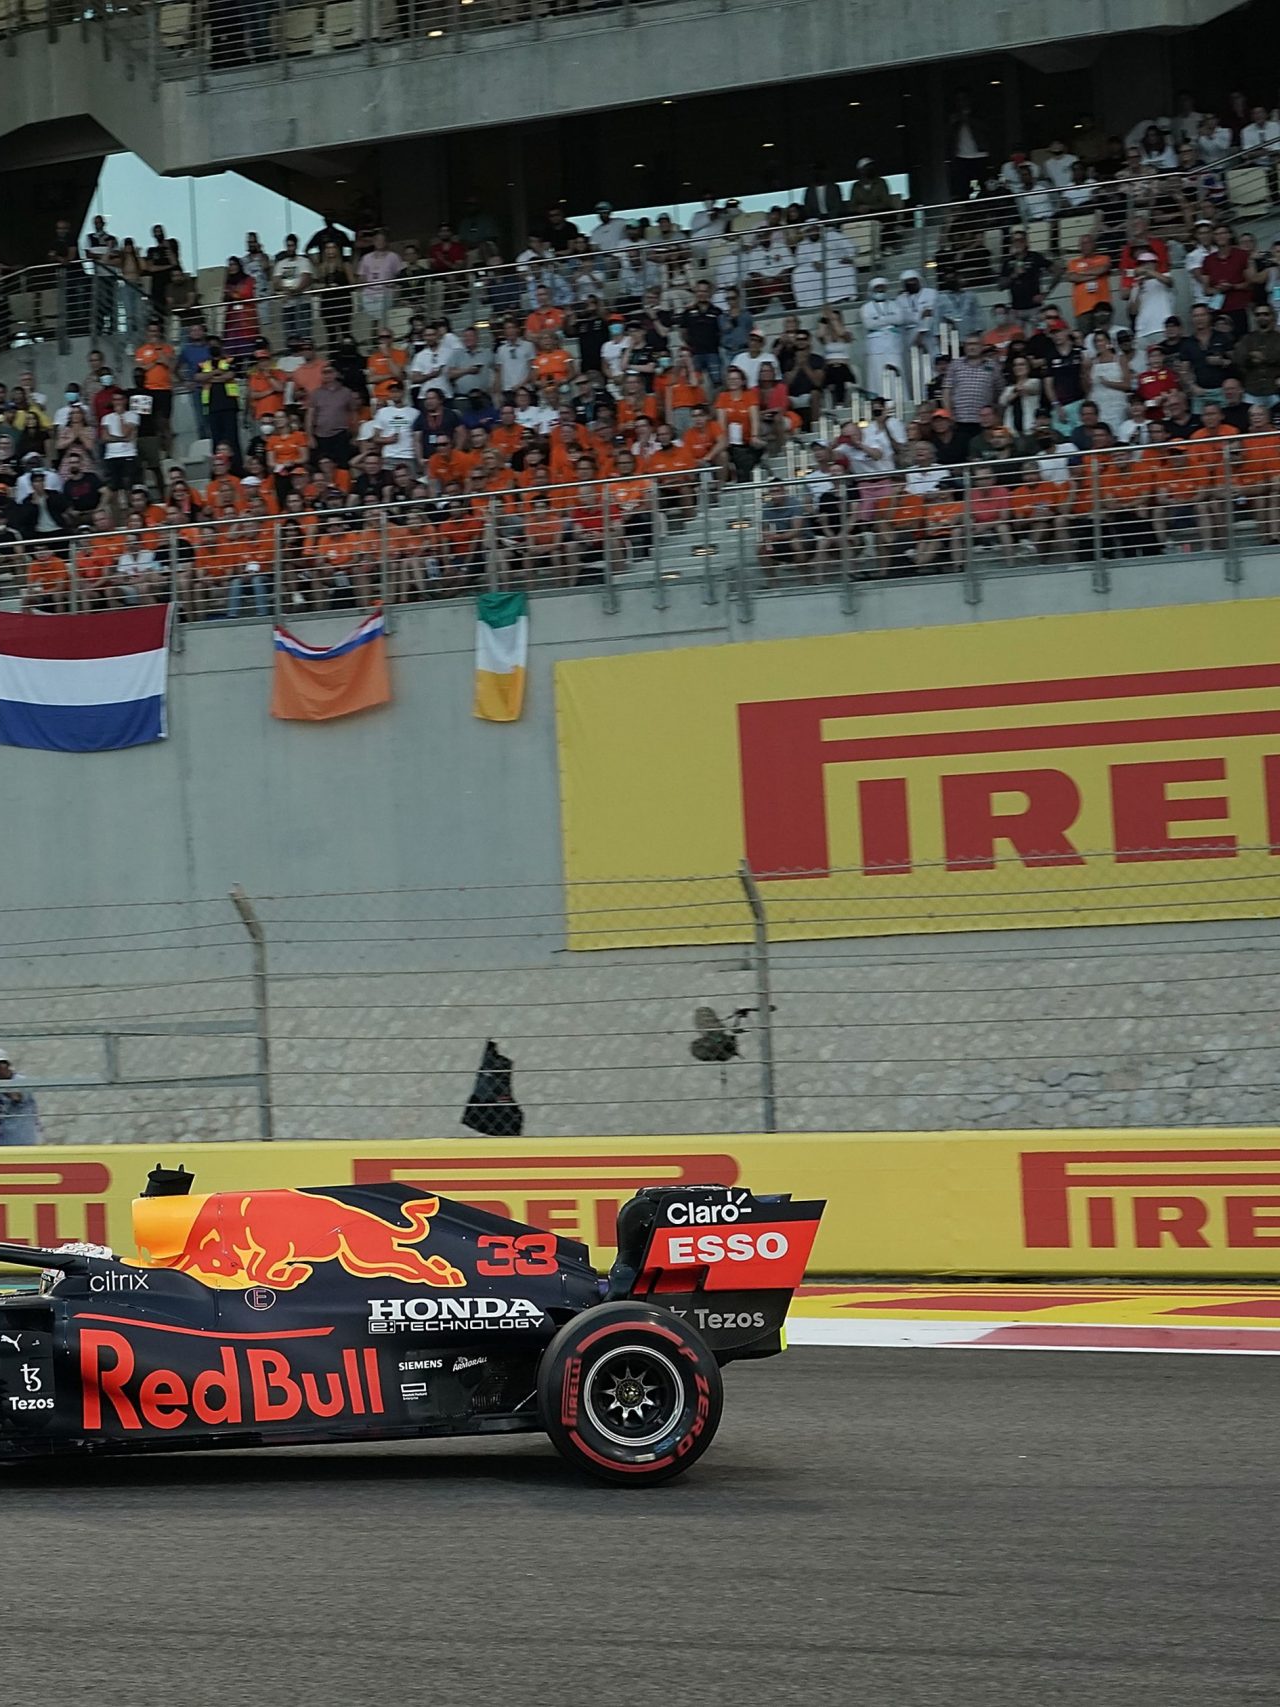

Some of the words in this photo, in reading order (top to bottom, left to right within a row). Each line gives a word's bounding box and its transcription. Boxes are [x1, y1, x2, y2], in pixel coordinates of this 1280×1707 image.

[738, 664, 1280, 881] PIRE
[667, 1200, 741, 1224] Claro
[477, 1233, 559, 1276] 33
[668, 1232, 788, 1264] ESSO
[89, 1269, 149, 1292] citrix
[368, 1298, 544, 1320] HONDA
[694, 1308, 765, 1329] Tezos
[398, 1359, 443, 1371] SIEMENS
[9, 1396, 55, 1411] Tezos
[561, 1357, 582, 1427] PIRELLI
[676, 1372, 710, 1458] ZERO
